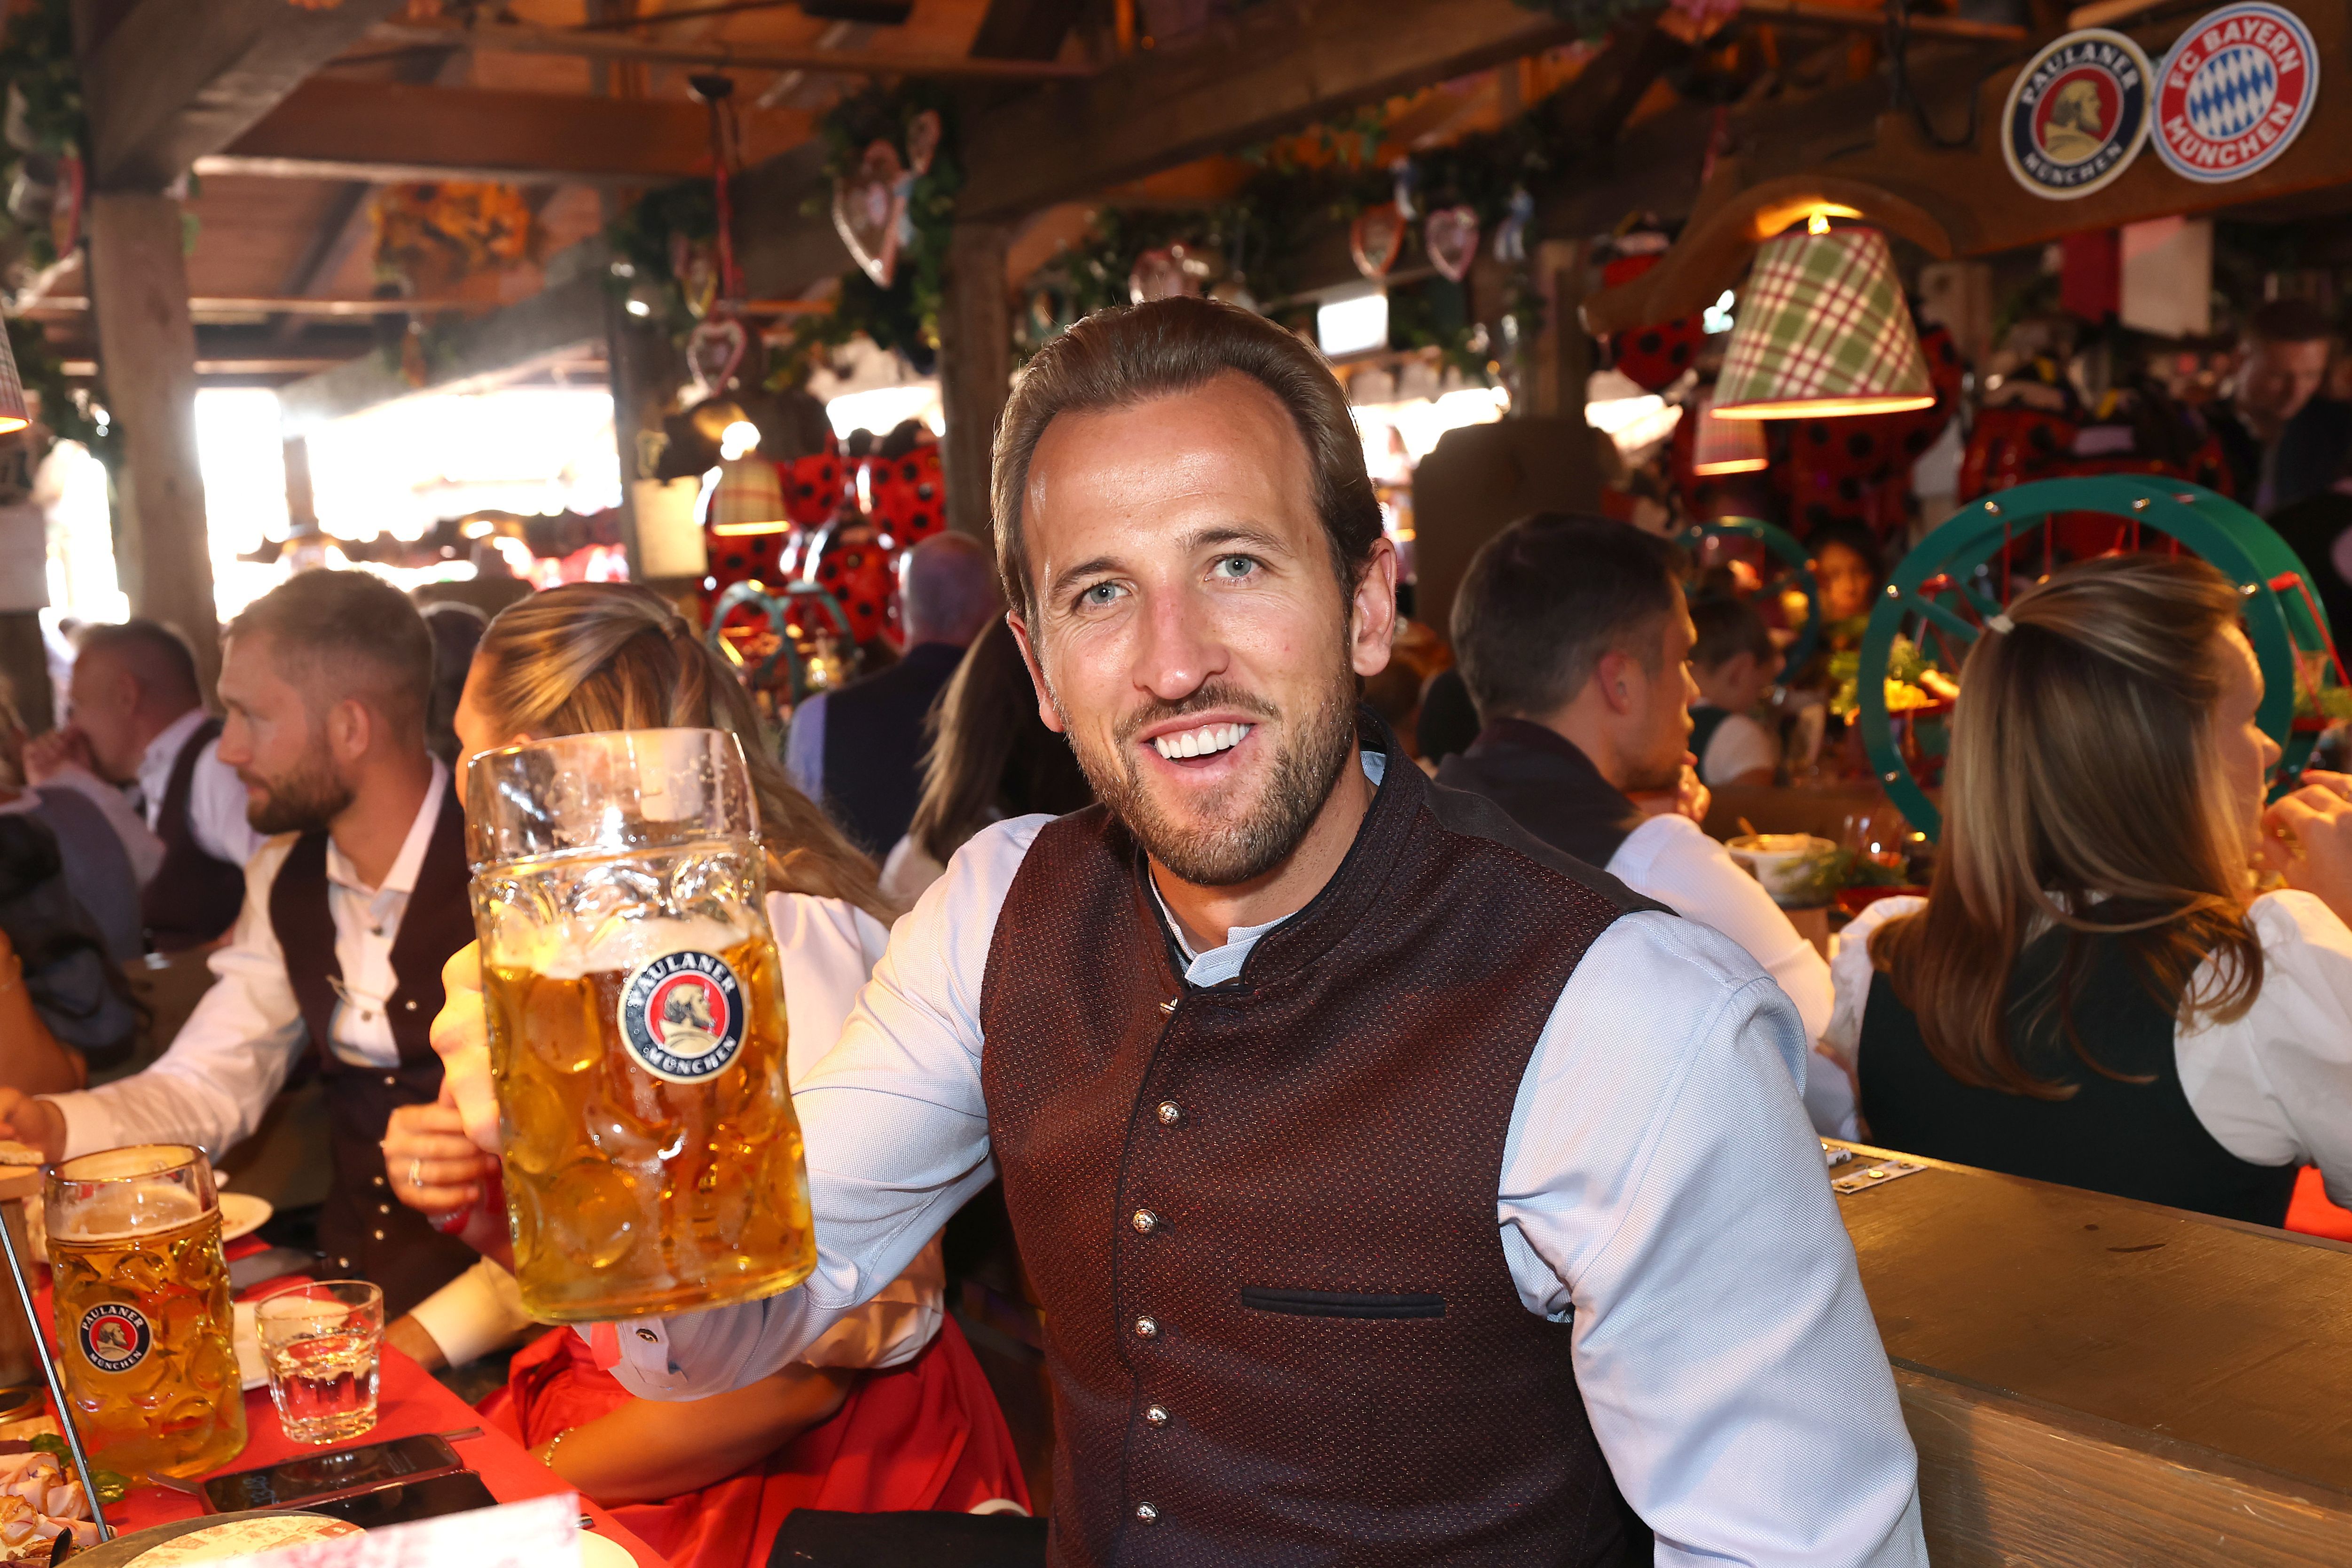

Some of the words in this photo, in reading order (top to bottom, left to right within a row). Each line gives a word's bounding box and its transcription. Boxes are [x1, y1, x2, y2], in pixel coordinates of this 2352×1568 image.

[2021, 41, 2139, 104] PAULANER
[2168, 49, 2200, 89] FC
[2203, 18, 2301, 74] BAYERN
[628, 952, 736, 1006] PAULANER
[82, 1306, 143, 1330] PAULANER
